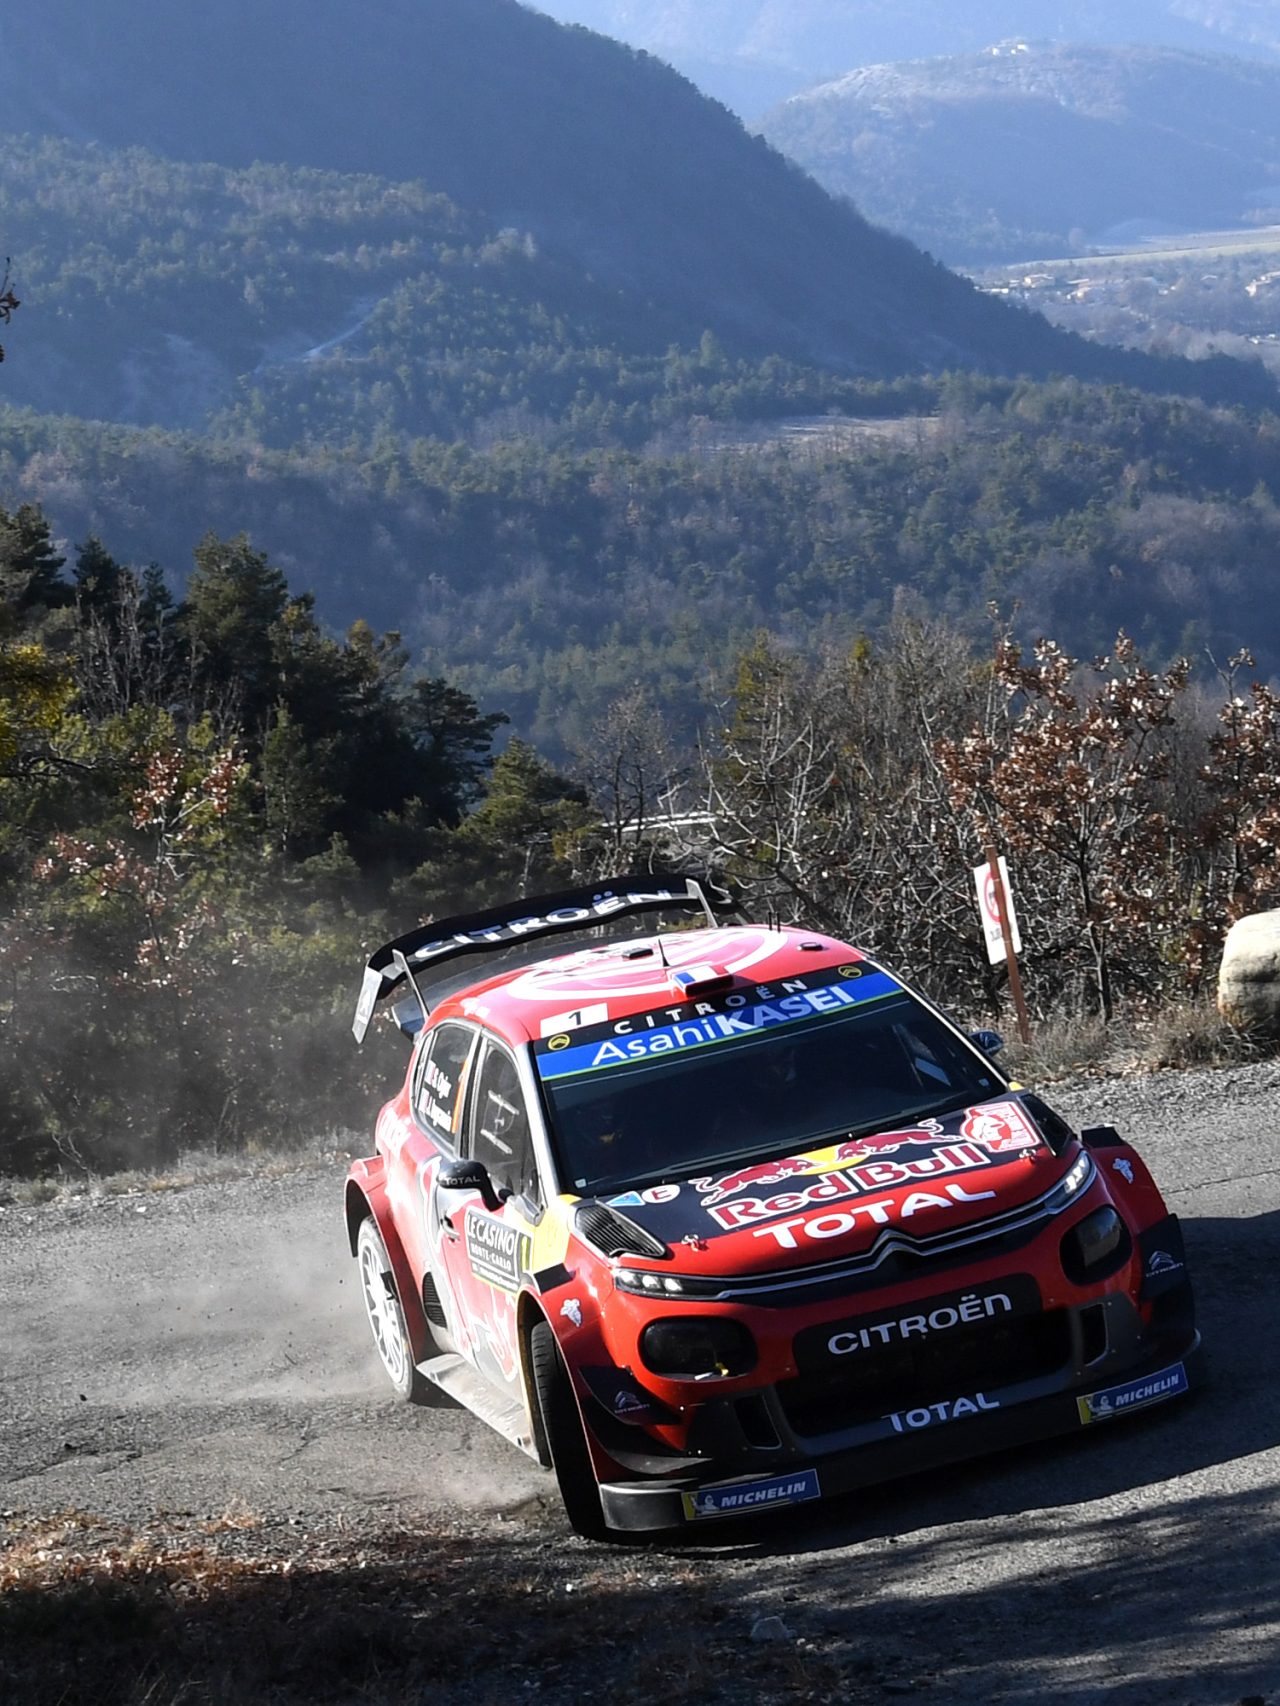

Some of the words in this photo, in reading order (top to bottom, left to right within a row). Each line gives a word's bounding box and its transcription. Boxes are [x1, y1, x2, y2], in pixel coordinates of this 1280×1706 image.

[414, 890, 671, 958] CITROËN
[569, 1010, 583, 1027] 1
[591, 985, 856, 1067] AsahiKASEI
[614, 979, 808, 1034] CITROËN
[444, 1175, 481, 1186] TOTAL
[707, 1171, 857, 1230] Red
[847, 1143, 991, 1190] Bull
[468, 1214, 476, 1238] LE
[476, 1218, 515, 1256] CASINO
[752, 1184, 996, 1249] TOTAL
[827, 1293, 1012, 1355] CITROËN
[881, 1392, 1000, 1432] TOTAL
[1115, 1373, 1179, 1406] MICHELIN
[721, 1481, 806, 1507] MICHELIN
